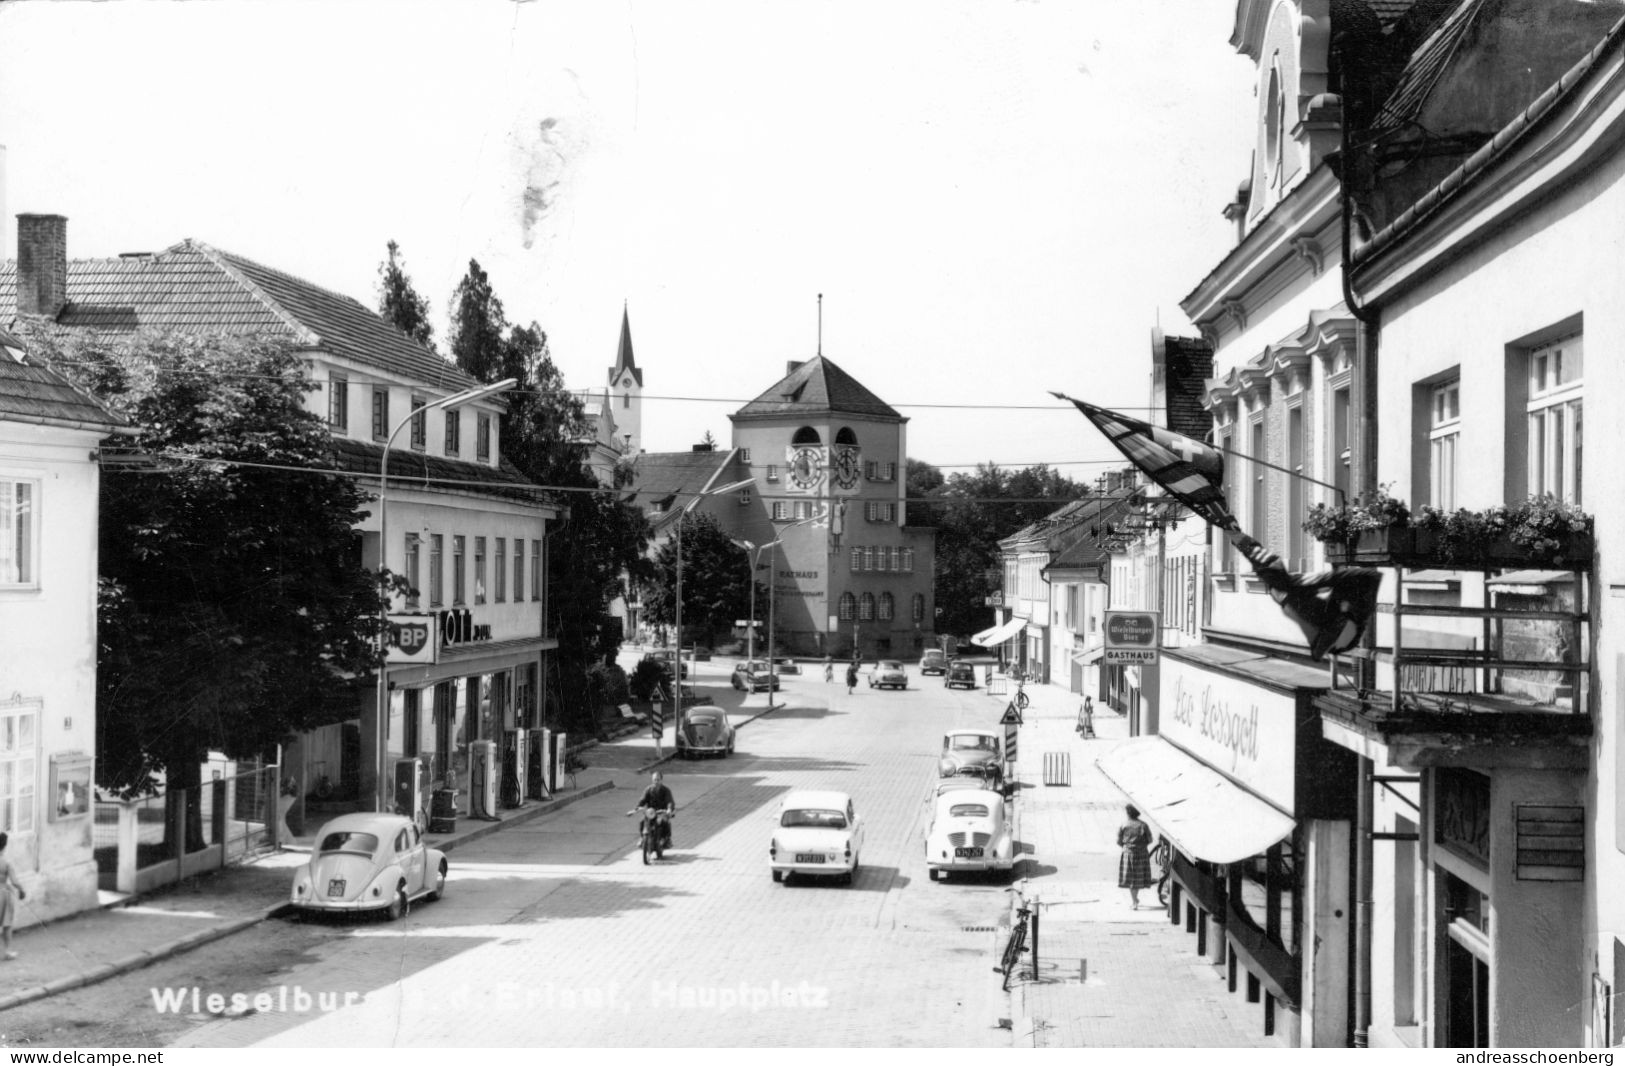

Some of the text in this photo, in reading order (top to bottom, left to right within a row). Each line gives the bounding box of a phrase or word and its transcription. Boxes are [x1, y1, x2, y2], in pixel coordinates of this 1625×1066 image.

[779, 571, 819, 579] RATHAUS
[400, 628, 426, 647] BP
[1107, 651, 1155, 660] GASTHAUS
